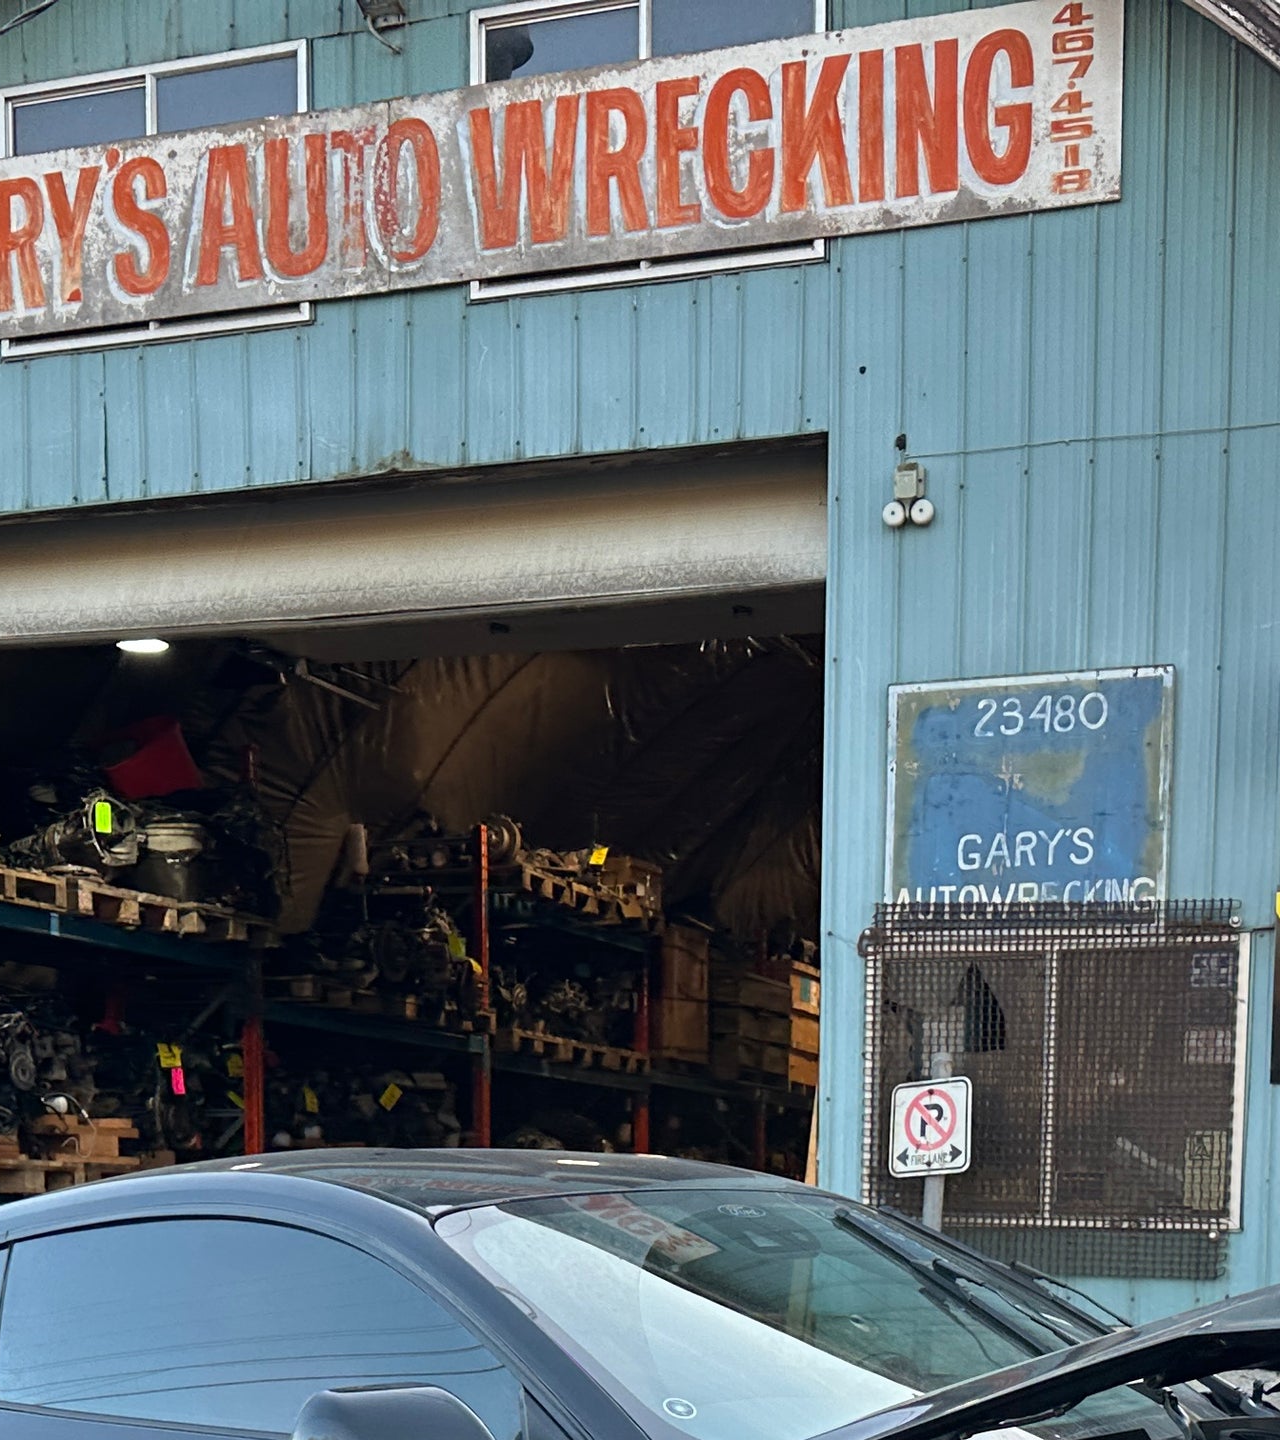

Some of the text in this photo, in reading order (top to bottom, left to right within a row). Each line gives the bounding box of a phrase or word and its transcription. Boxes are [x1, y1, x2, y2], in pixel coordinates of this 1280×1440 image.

[195, 117, 442, 287] AUTO
[468, 28, 1035, 250] WRECKING
[974, 692, 1108, 737] 23480
[957, 827, 1094, 870] GARY'S
[911, 1153, 926, 1166] FIRE
